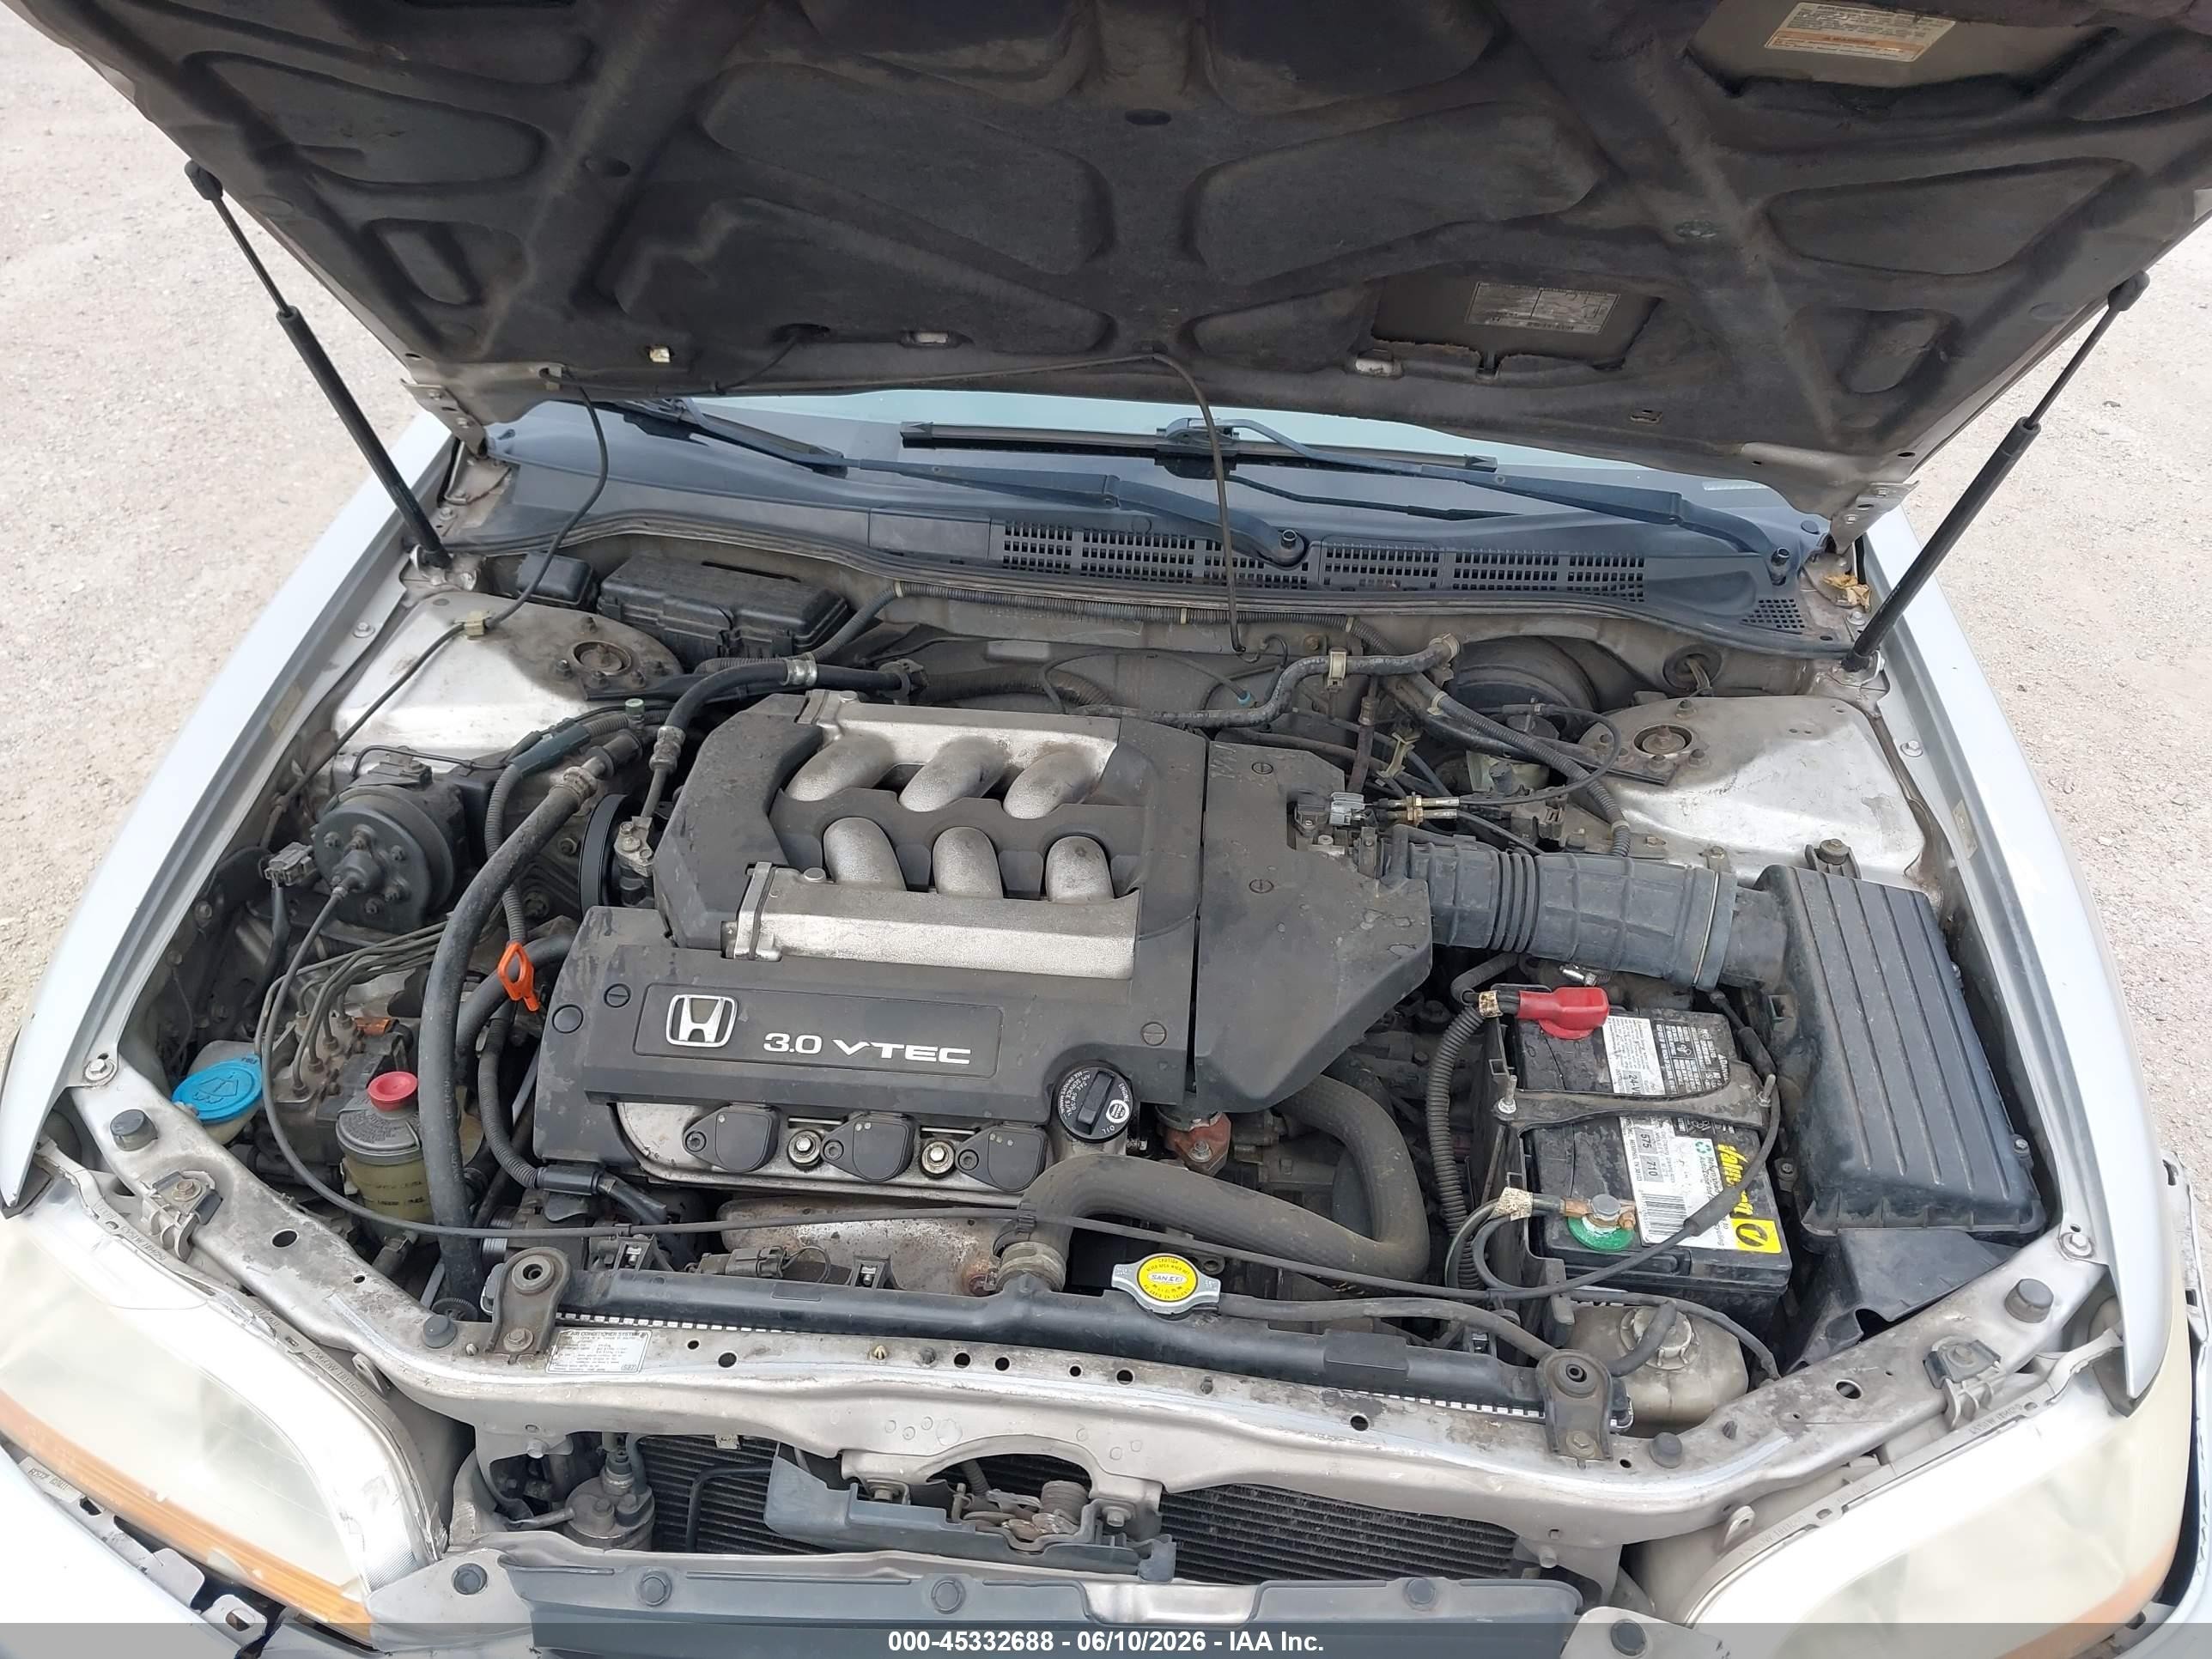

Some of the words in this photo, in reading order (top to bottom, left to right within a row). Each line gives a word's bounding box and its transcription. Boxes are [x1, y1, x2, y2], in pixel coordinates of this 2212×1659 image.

[763, 1032, 823, 1054] 3.0
[833, 1039, 971, 1065] VTEC
[1118, 1083, 1129, 1103] ENGINE
[1640, 1133, 1652, 1149] 575
[1646, 1160, 1658, 1177] 710
